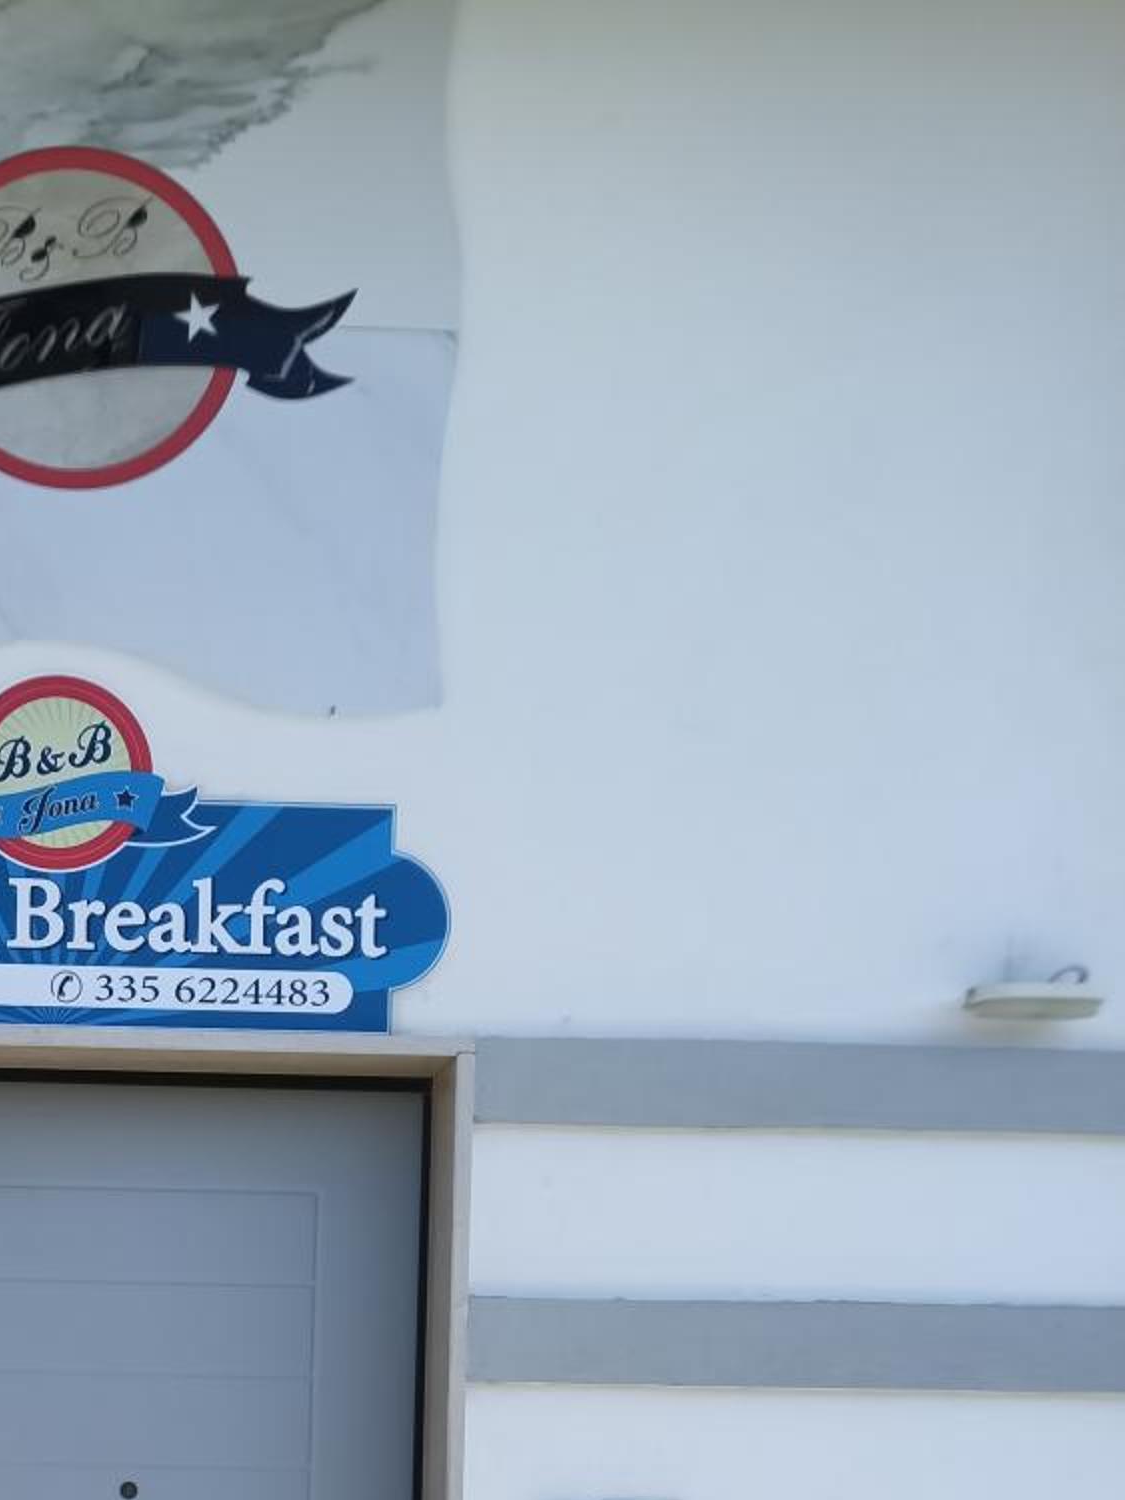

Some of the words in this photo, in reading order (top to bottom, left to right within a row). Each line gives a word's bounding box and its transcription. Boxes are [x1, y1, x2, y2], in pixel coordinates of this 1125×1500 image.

[6, 876, 388, 959] Breakfast
[95, 974, 160, 1002] 335
[174, 975, 331, 1007] 6224483
